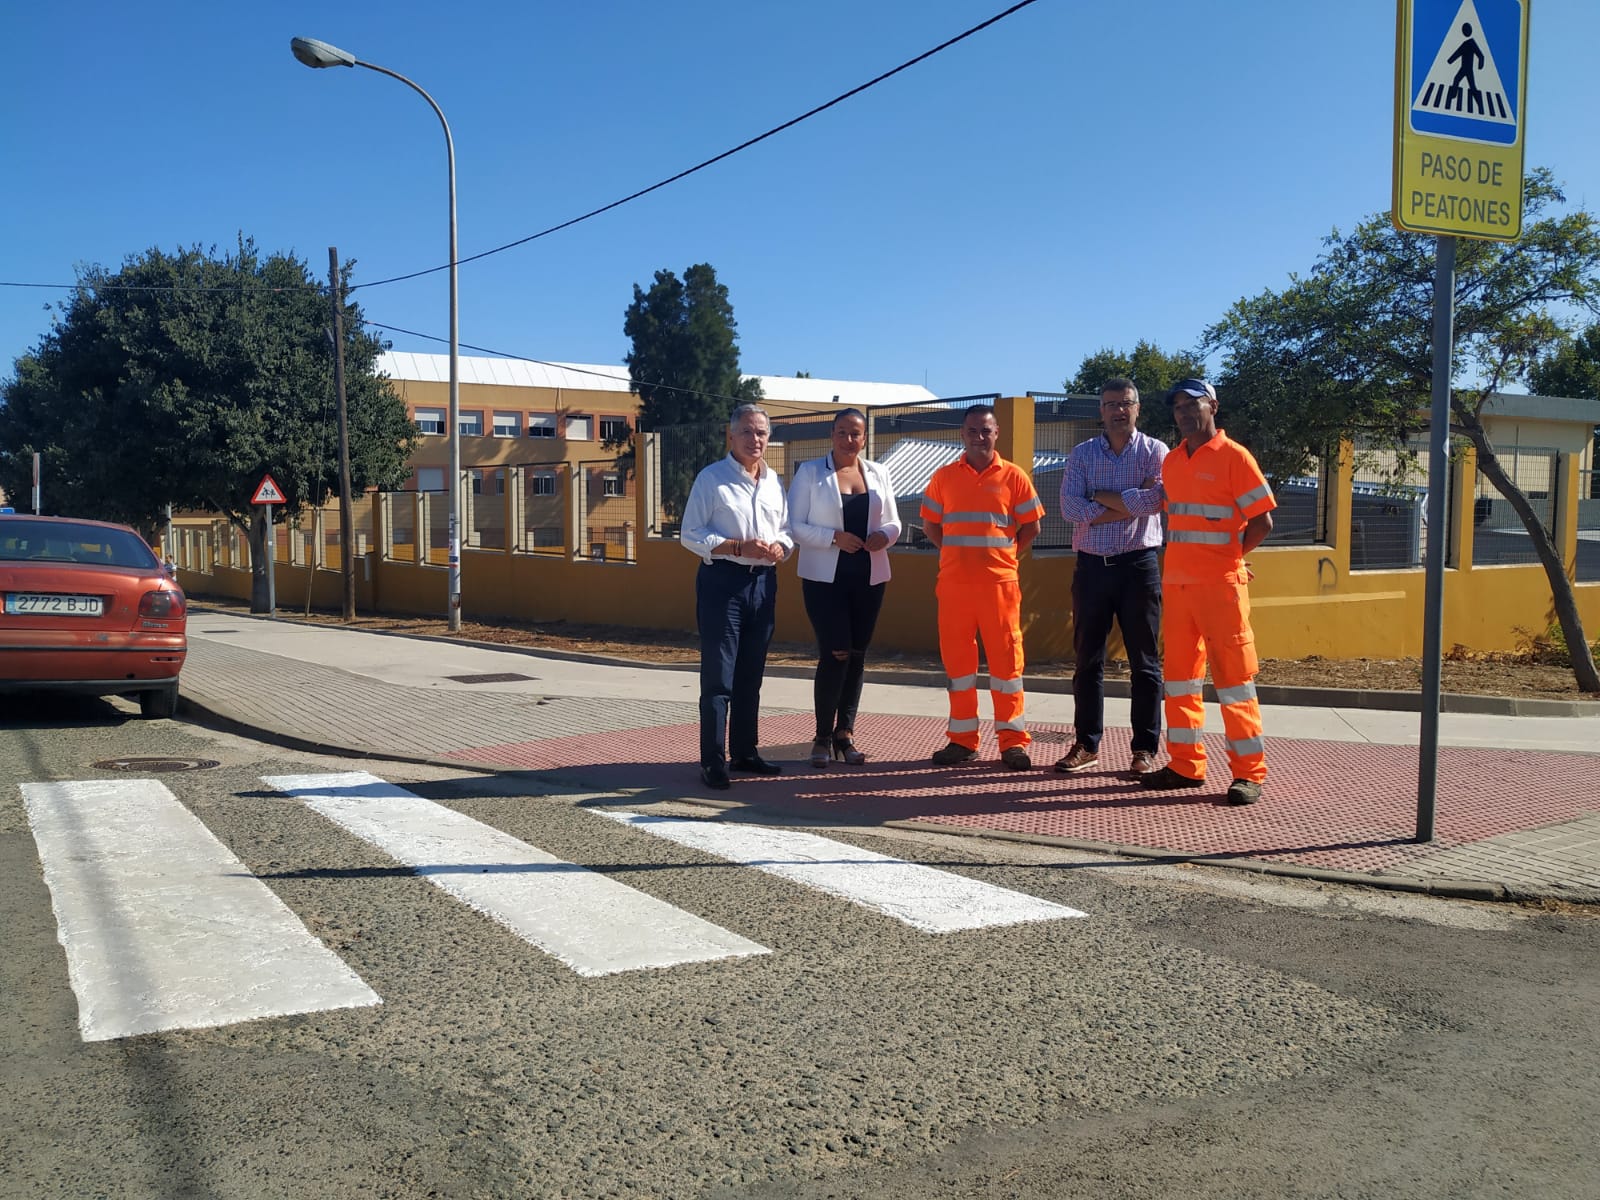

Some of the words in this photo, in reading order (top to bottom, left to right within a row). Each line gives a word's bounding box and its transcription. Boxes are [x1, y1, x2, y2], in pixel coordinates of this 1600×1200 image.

[1421, 152, 1471, 182] PASO
[1478, 160, 1503, 186] DE
[1411, 191, 1511, 226] PEATONES
[18, 596, 62, 611] 2772
[67, 598, 98, 612] BJD
